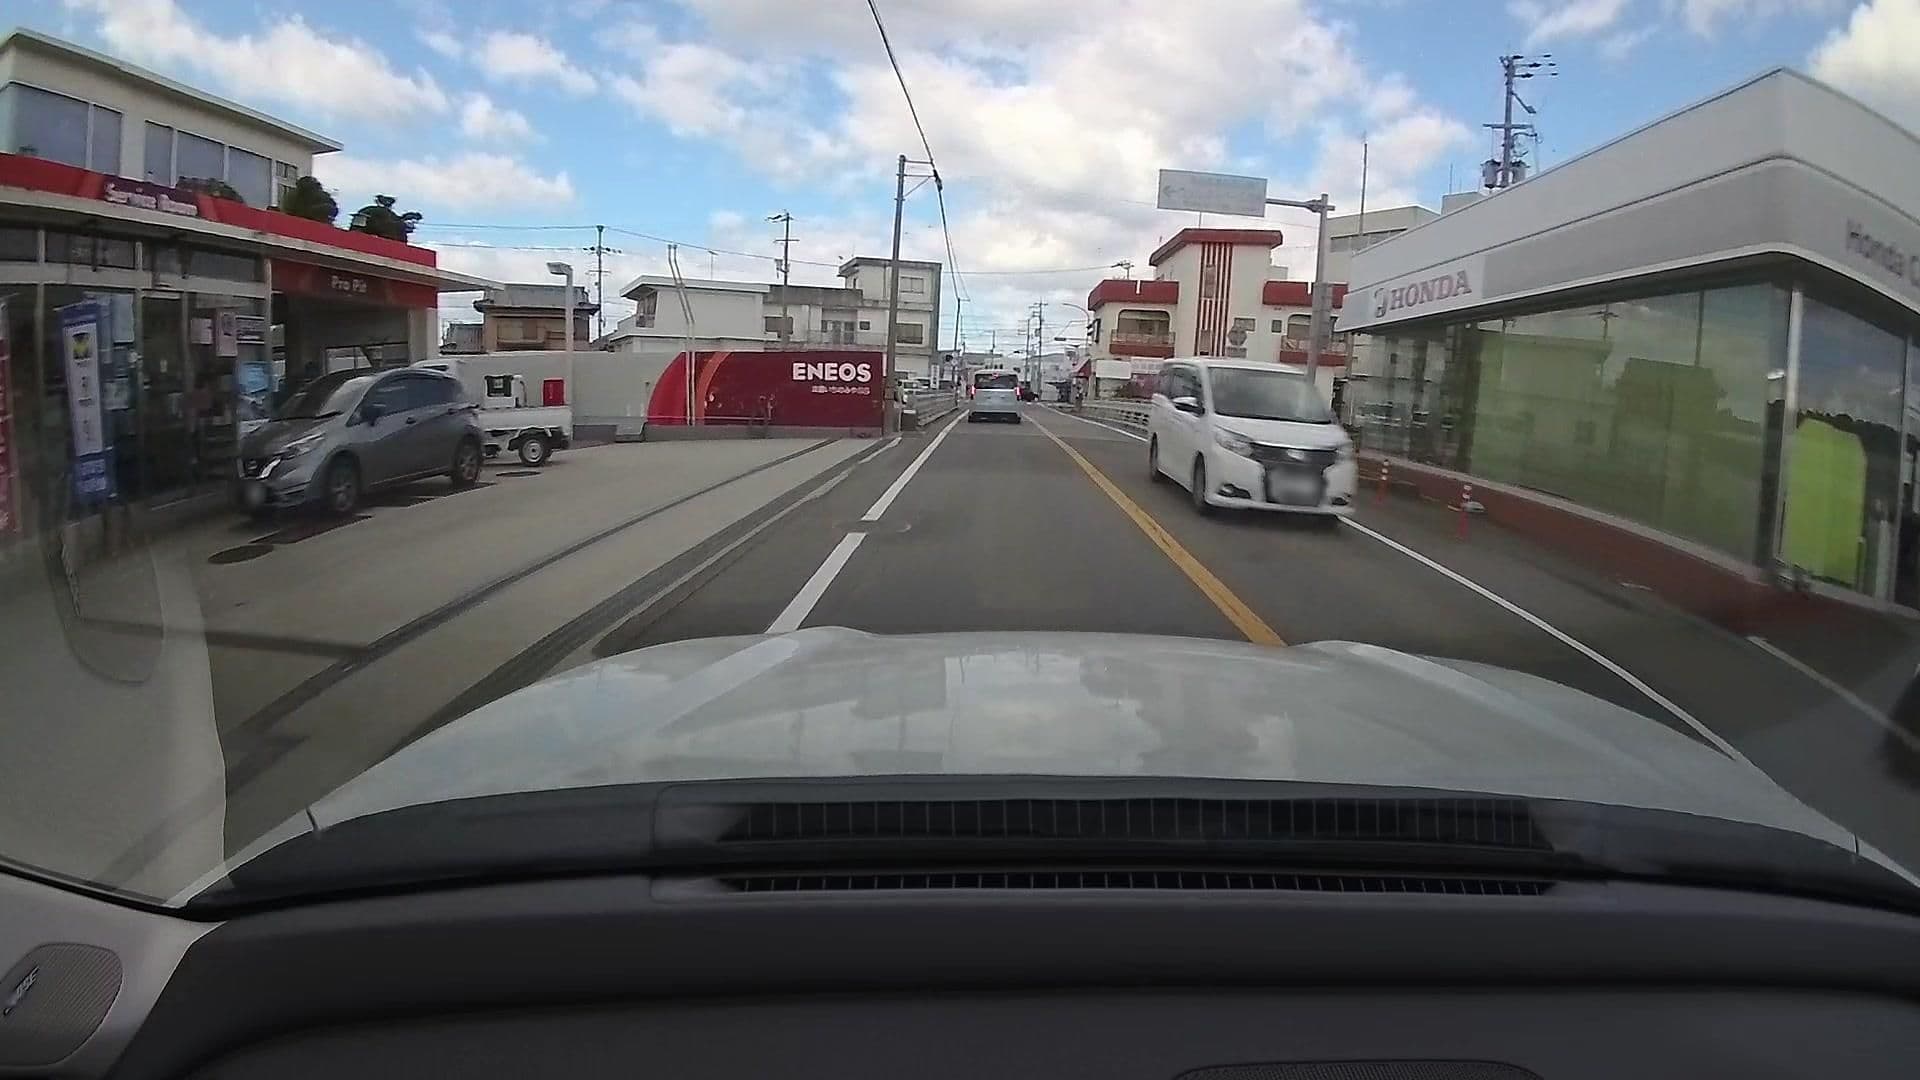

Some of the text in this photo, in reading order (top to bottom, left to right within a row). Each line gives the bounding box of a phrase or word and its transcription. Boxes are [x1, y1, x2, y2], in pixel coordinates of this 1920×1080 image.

[331, 275, 350, 290] Pro
[1389, 270, 1472, 310] HONDA
[793, 362, 871, 382] ENEOS
